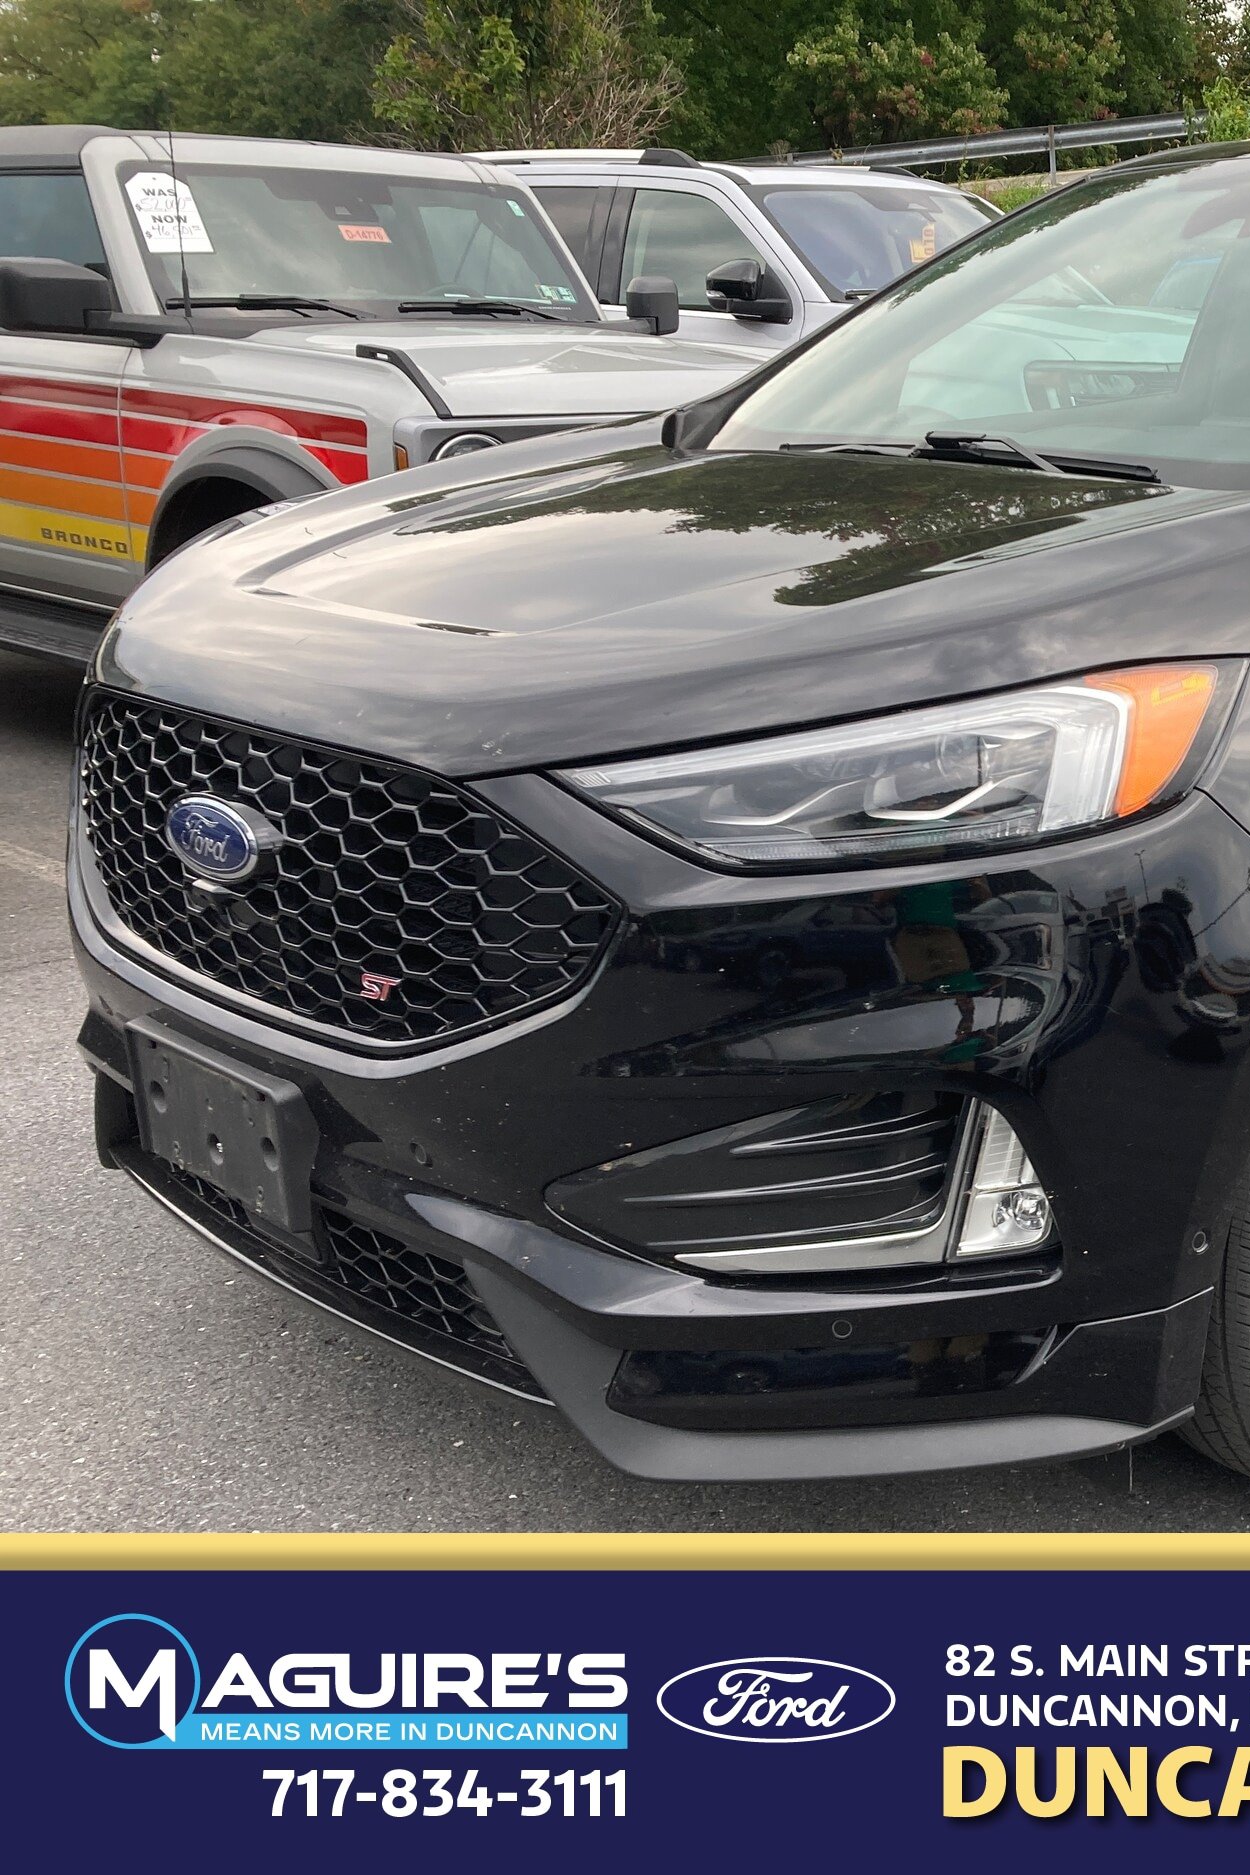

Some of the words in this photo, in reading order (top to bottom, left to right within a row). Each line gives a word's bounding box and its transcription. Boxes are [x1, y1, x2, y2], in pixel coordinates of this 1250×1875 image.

[142, 188, 177, 197] WAS
[151, 215, 188, 223] NOW
[41, 527, 129, 555] BRONCO
[181, 812, 230, 863] Ford
[361, 973, 402, 1002] ST
